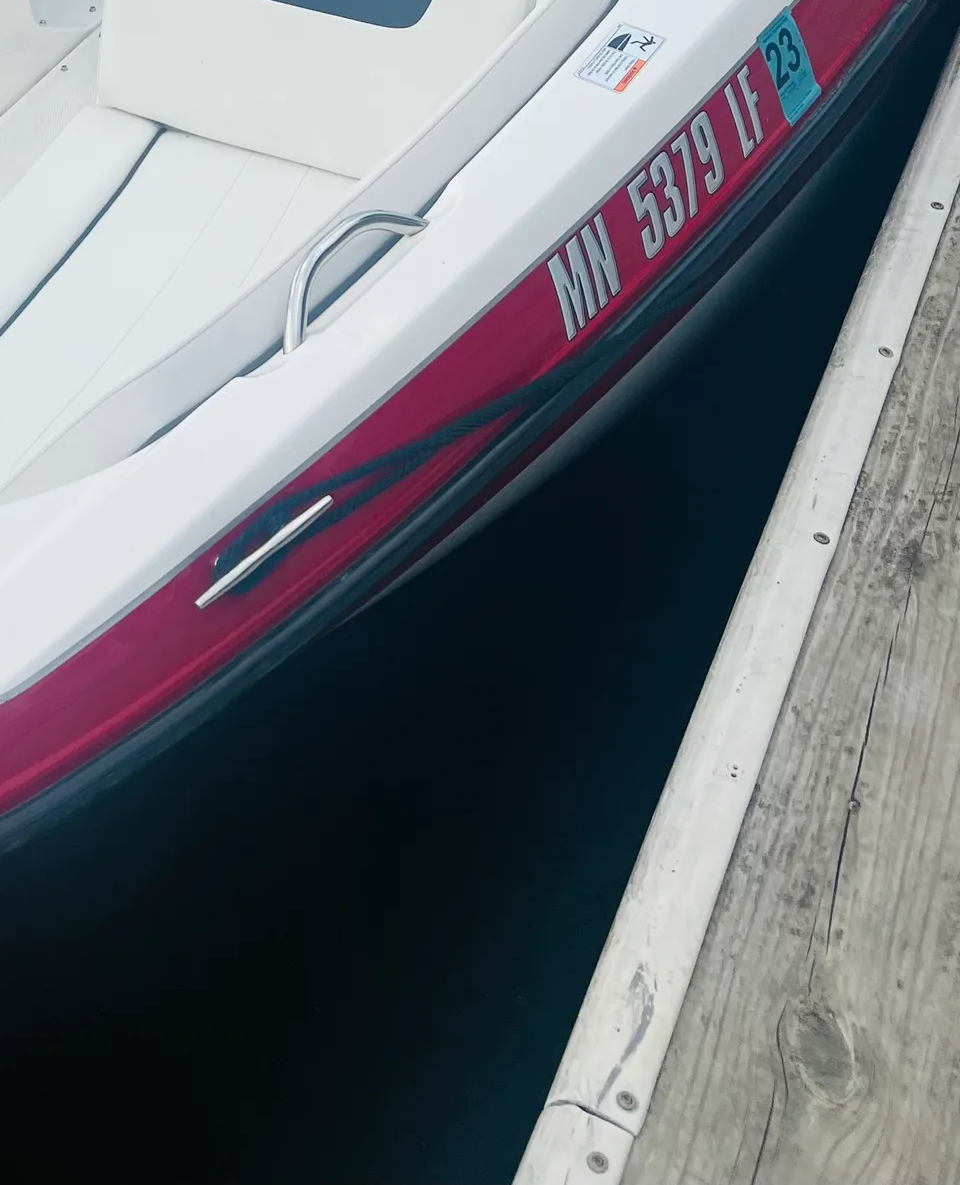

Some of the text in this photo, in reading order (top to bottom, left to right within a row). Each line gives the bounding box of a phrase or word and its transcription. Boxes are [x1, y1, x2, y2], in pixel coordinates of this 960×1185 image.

[765, 27, 801, 91] 23
[546, 64, 765, 342] MN 5379 LF
